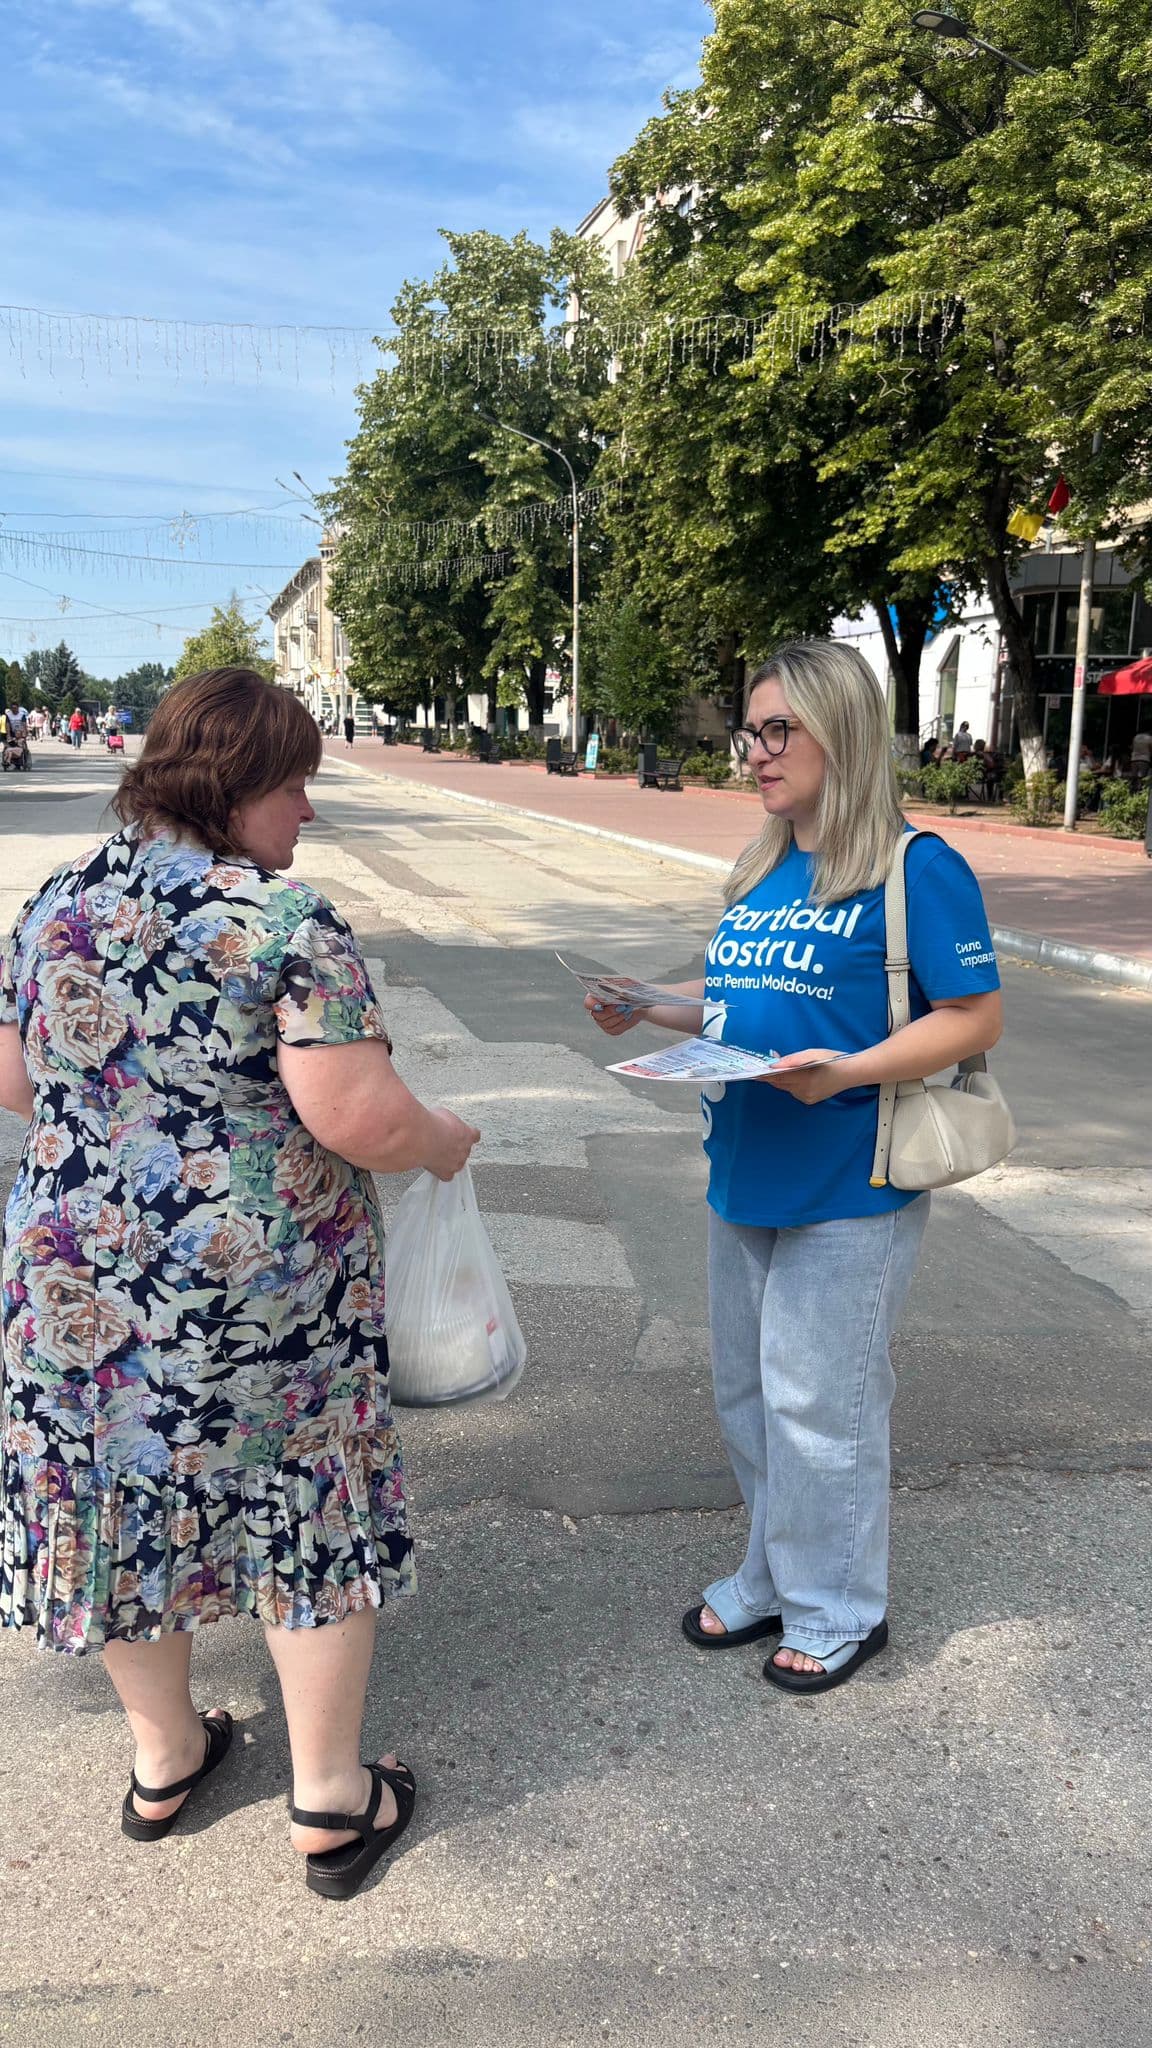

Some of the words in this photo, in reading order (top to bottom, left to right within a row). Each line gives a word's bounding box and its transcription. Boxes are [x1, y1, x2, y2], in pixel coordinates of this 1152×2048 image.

[718, 899, 863, 938] Partidul
[955, 941, 982, 954] Сила
[705, 976, 722, 988] oar
[724, 973, 760, 989] Pentru
[761, 973, 834, 1001] Moldova!
